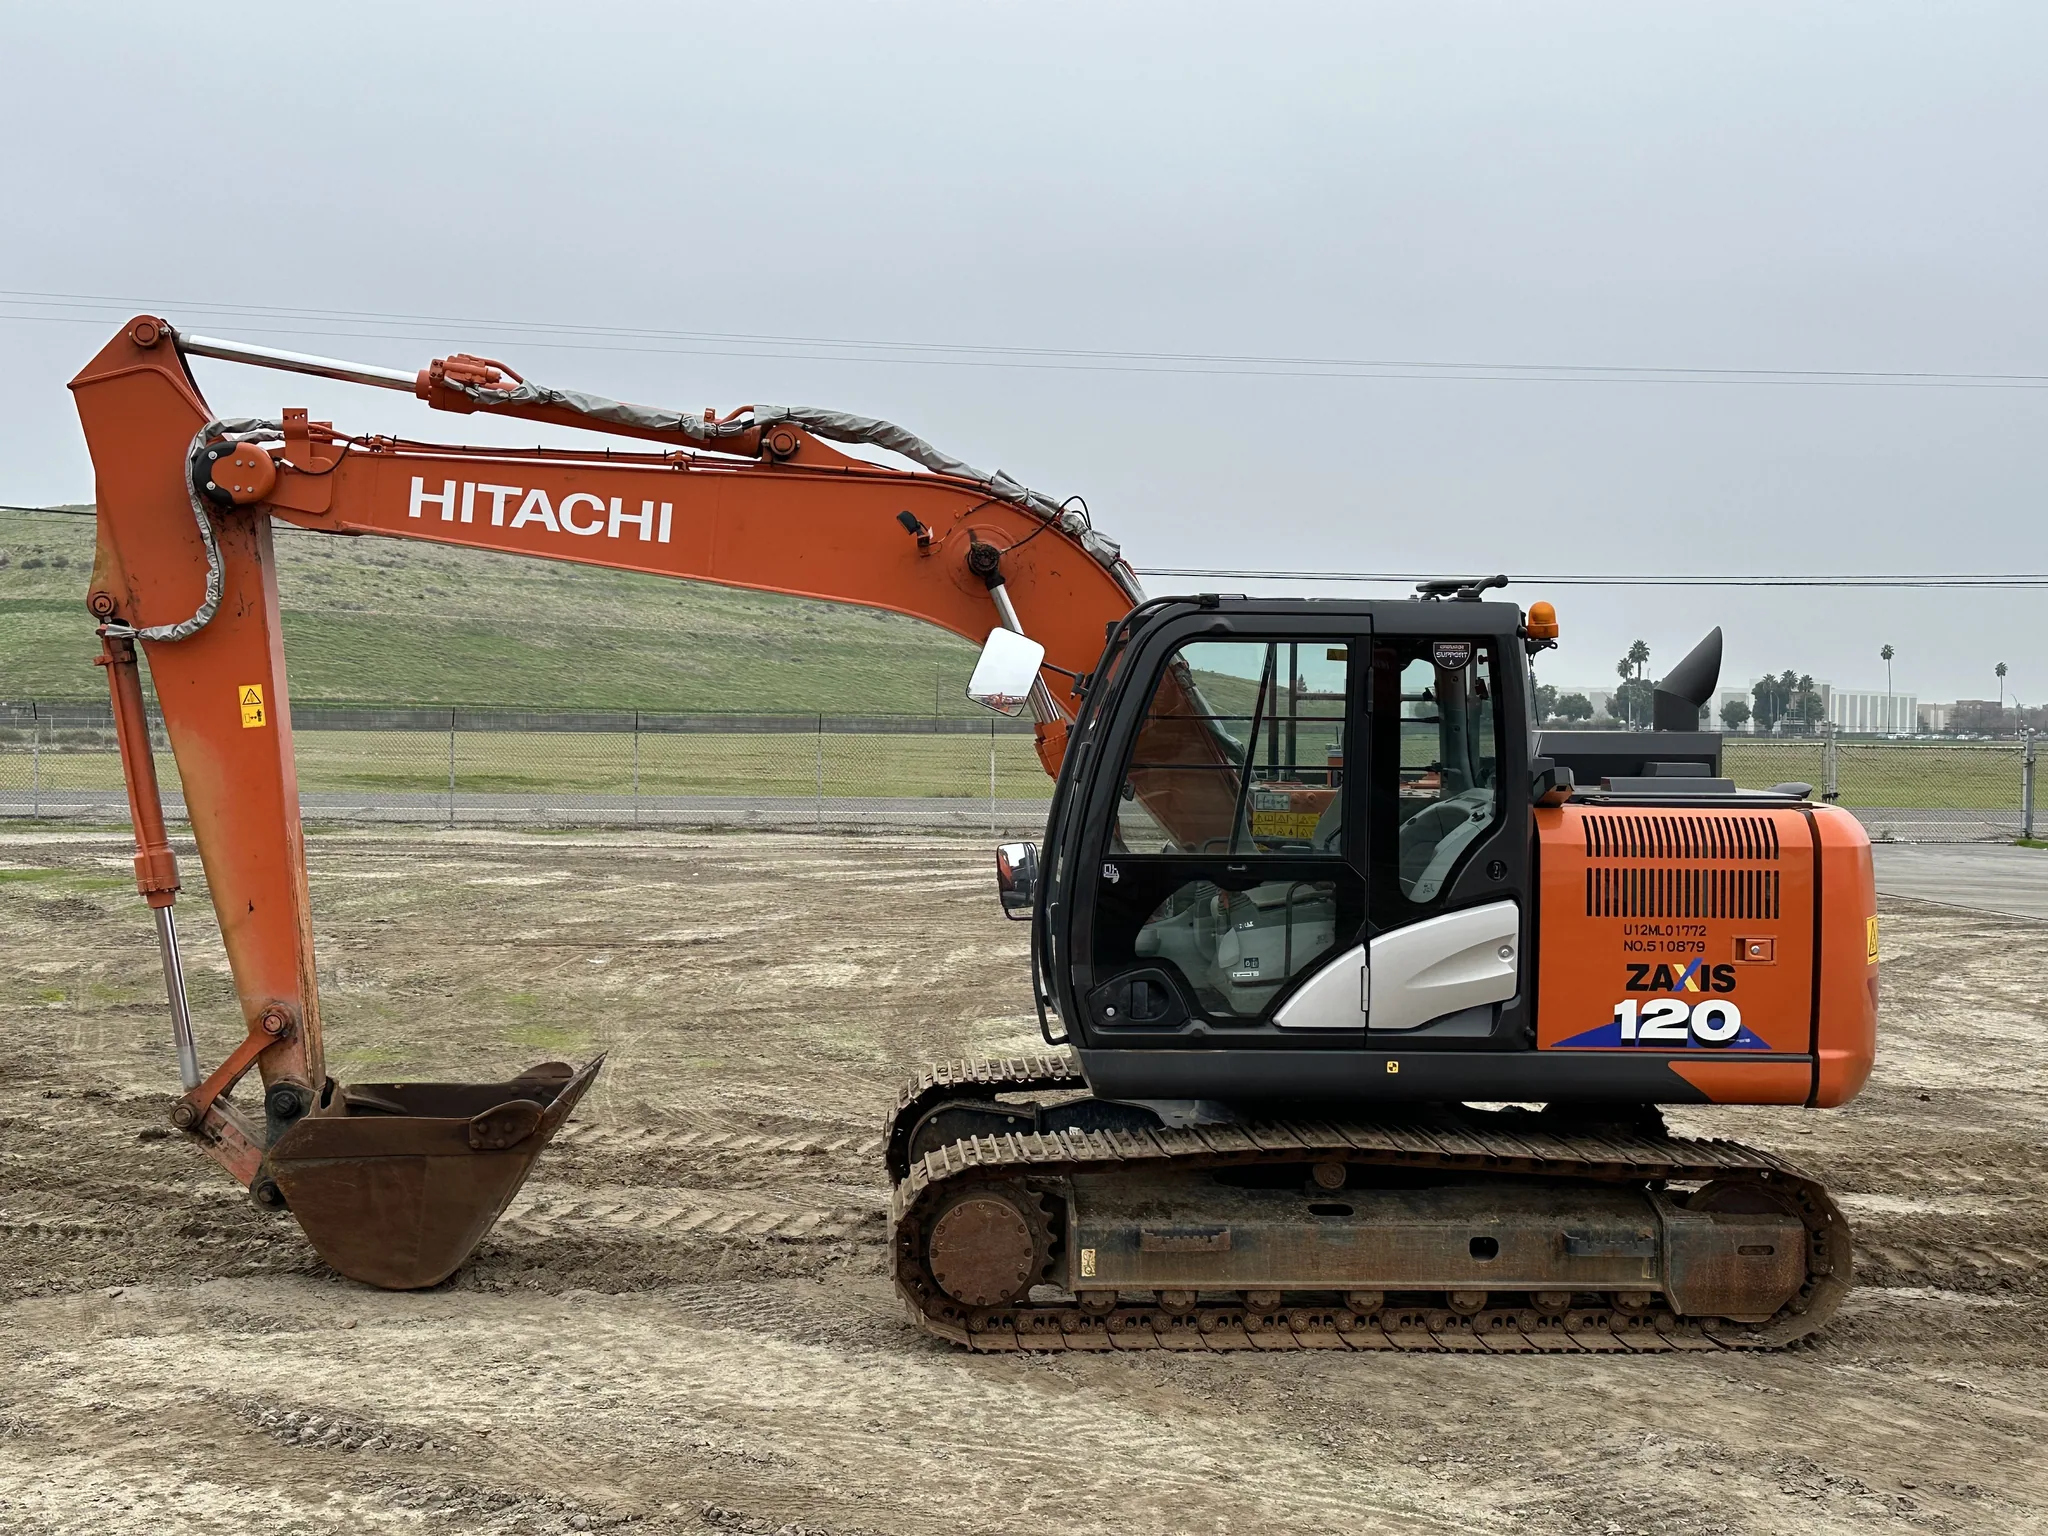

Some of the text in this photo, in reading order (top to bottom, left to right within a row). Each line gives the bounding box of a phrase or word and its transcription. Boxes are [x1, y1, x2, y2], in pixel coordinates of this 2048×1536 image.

[408, 476, 673, 543] HITACHI
[1623, 940, 1706, 952] NO.510879
[1624, 924, 1707, 937] U12ML01772
[1626, 957, 1736, 993] ZAXIS
[1614, 998, 1741, 1044] 120
